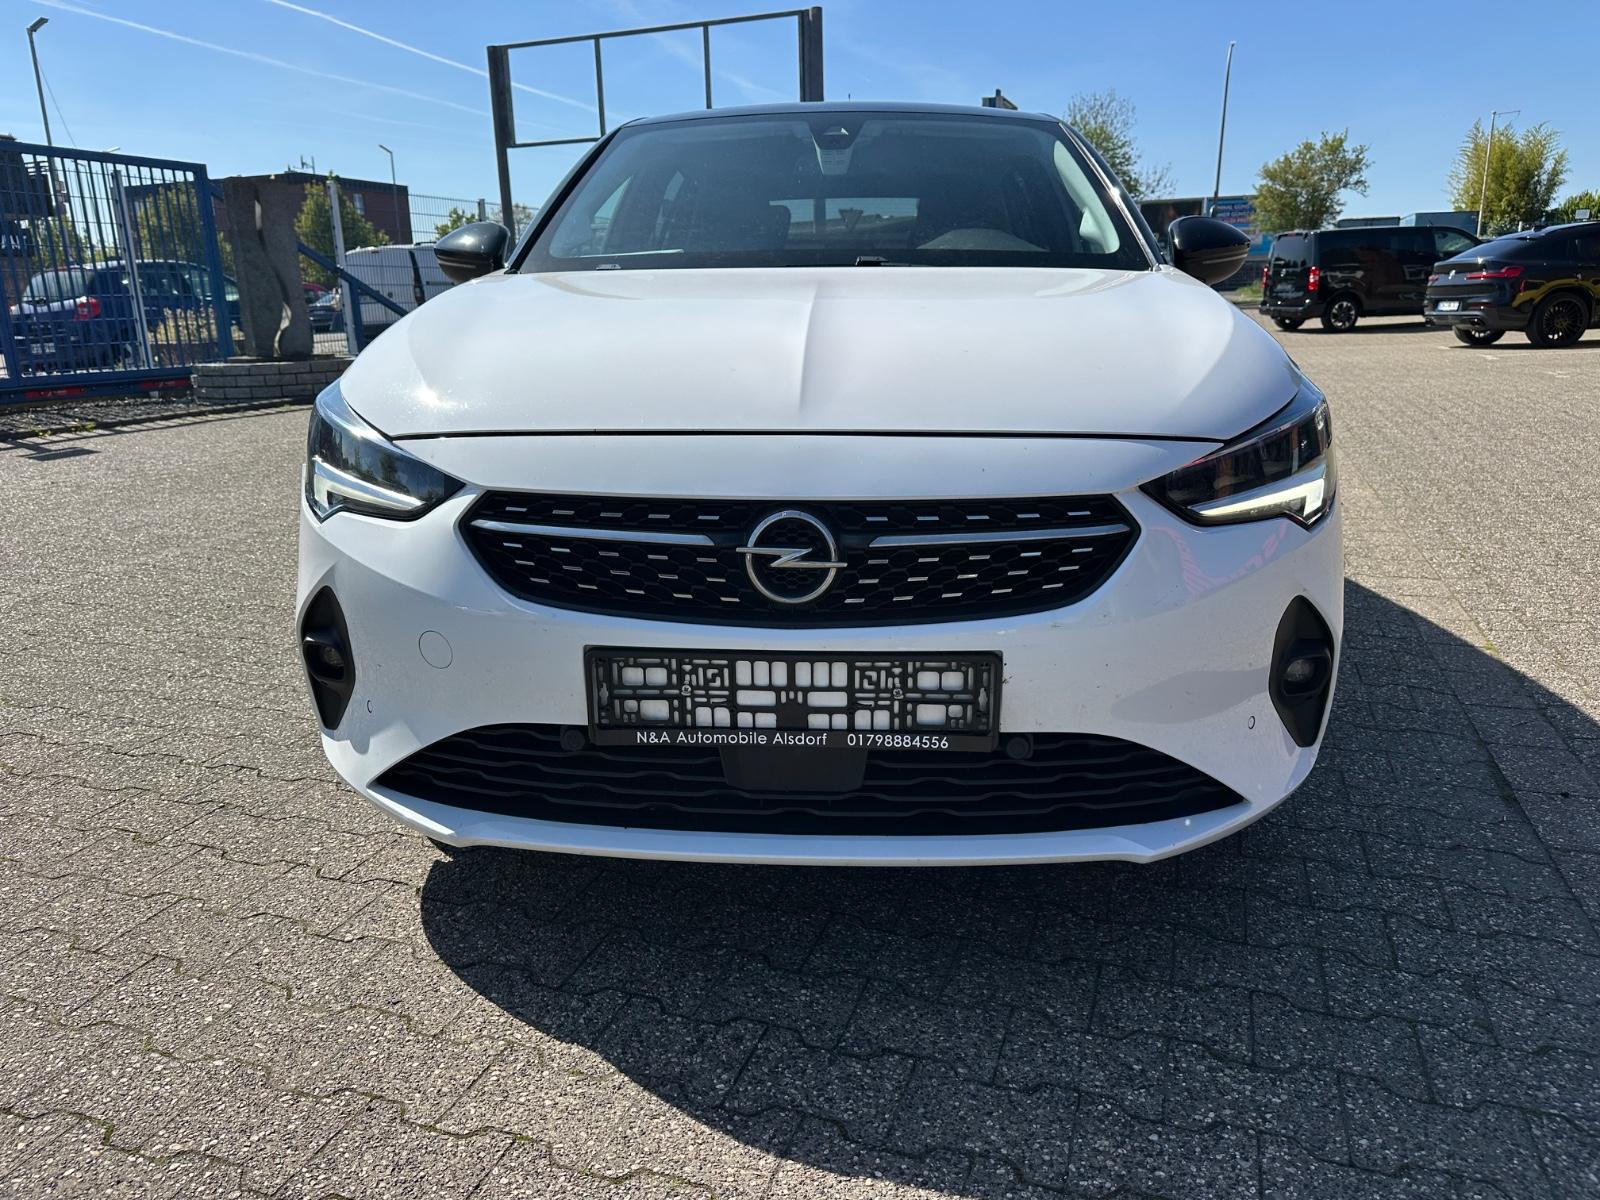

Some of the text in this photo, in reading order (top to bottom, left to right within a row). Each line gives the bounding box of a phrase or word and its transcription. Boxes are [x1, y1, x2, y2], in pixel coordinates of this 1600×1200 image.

[636, 731, 949, 749] N&A Automobile Alsdorf 01798884556
